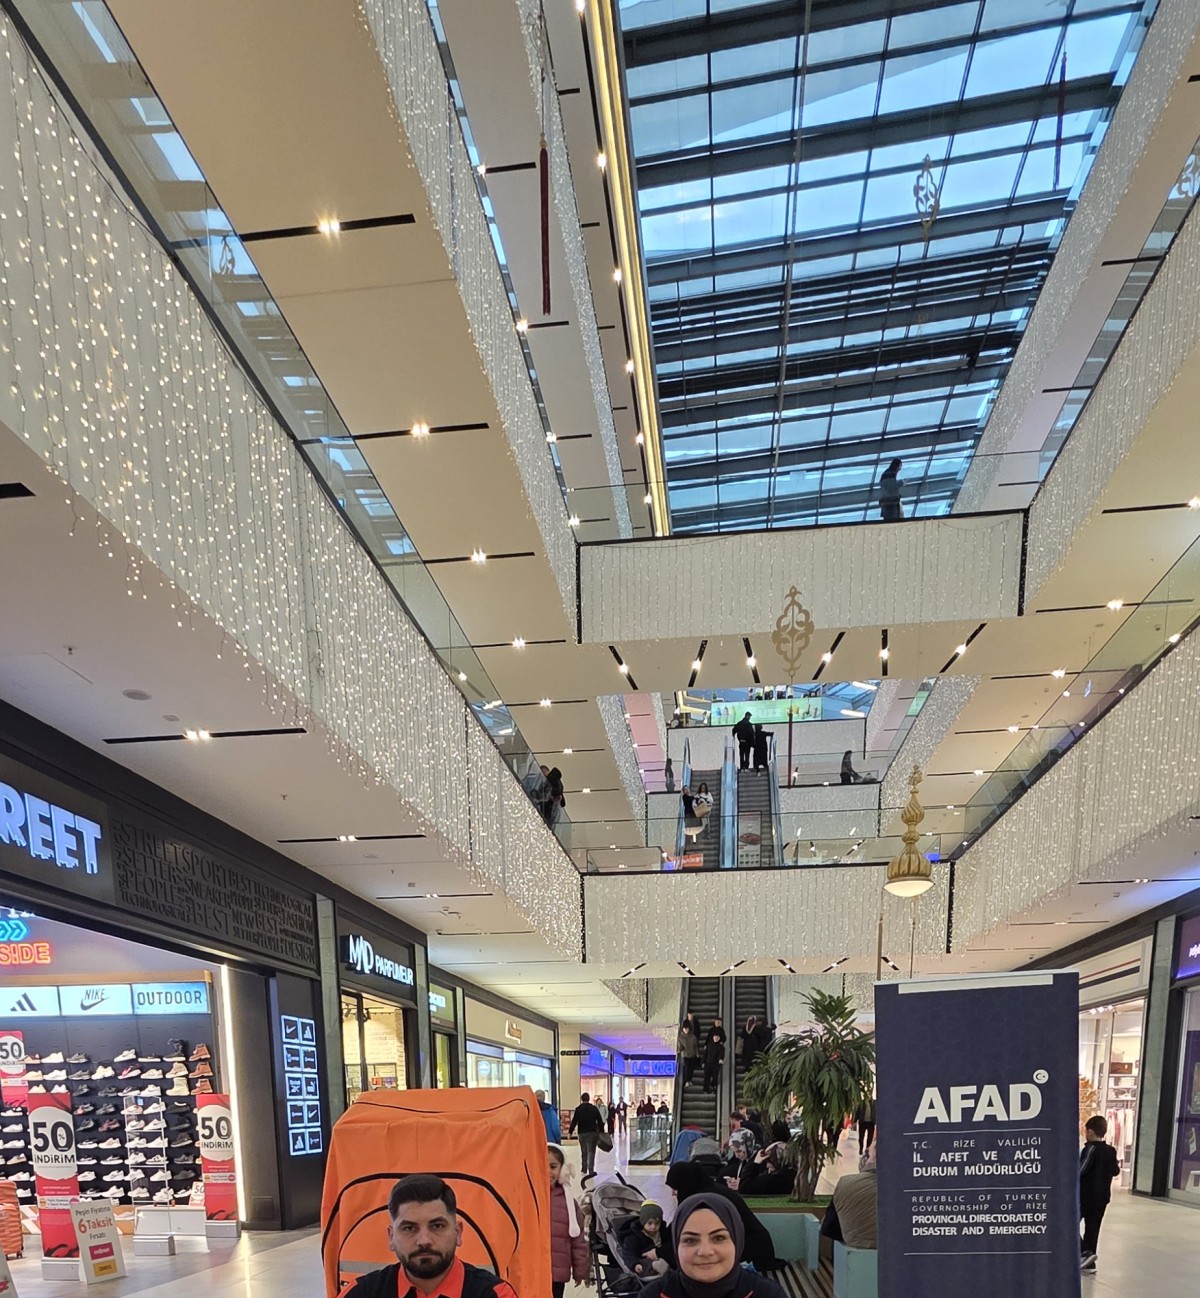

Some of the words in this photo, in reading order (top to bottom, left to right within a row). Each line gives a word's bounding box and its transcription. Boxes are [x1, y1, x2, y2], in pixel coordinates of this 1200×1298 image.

[0, 782, 101, 874] REET
[84, 988, 105, 1000] NIKE
[137, 990, 203, 1006] OUTDOOR
[913, 1083, 1043, 1125] AFAD
[201, 1116, 232, 1140] 50
[33, 1121, 74, 1152] 50
[913, 1151, 924, 1163] İL
[940, 1151, 969, 1162] AFET
[983, 1151, 998, 1161] VE
[1014, 1147, 1042, 1161] ACİL
[913, 1166, 958, 1177] DURUM
[964, 1161, 1042, 1176] MÜDÜRLÜĞÜ
[912, 1195, 965, 1203] REPUBLIC
[978, 1194, 992, 1202] OF
[1005, 1193, 1048, 1201] TURKEY
[912, 1204, 990, 1212] GOVERNORSHIP
[1000, 1203, 1014, 1211] OF
[78, 1219, 87, 1234] 6
[87, 1217, 113, 1230] Taksit
[912, 1214, 969, 1225] PROVINCIAL
[969, 1213, 1033, 1224] DIRECTORATE
[1034, 1213, 1047, 1222] OF
[912, 1227, 958, 1237] DISASTER
[962, 1226, 984, 1236] AND
[989, 1225, 1047, 1235] EMERGENCY
